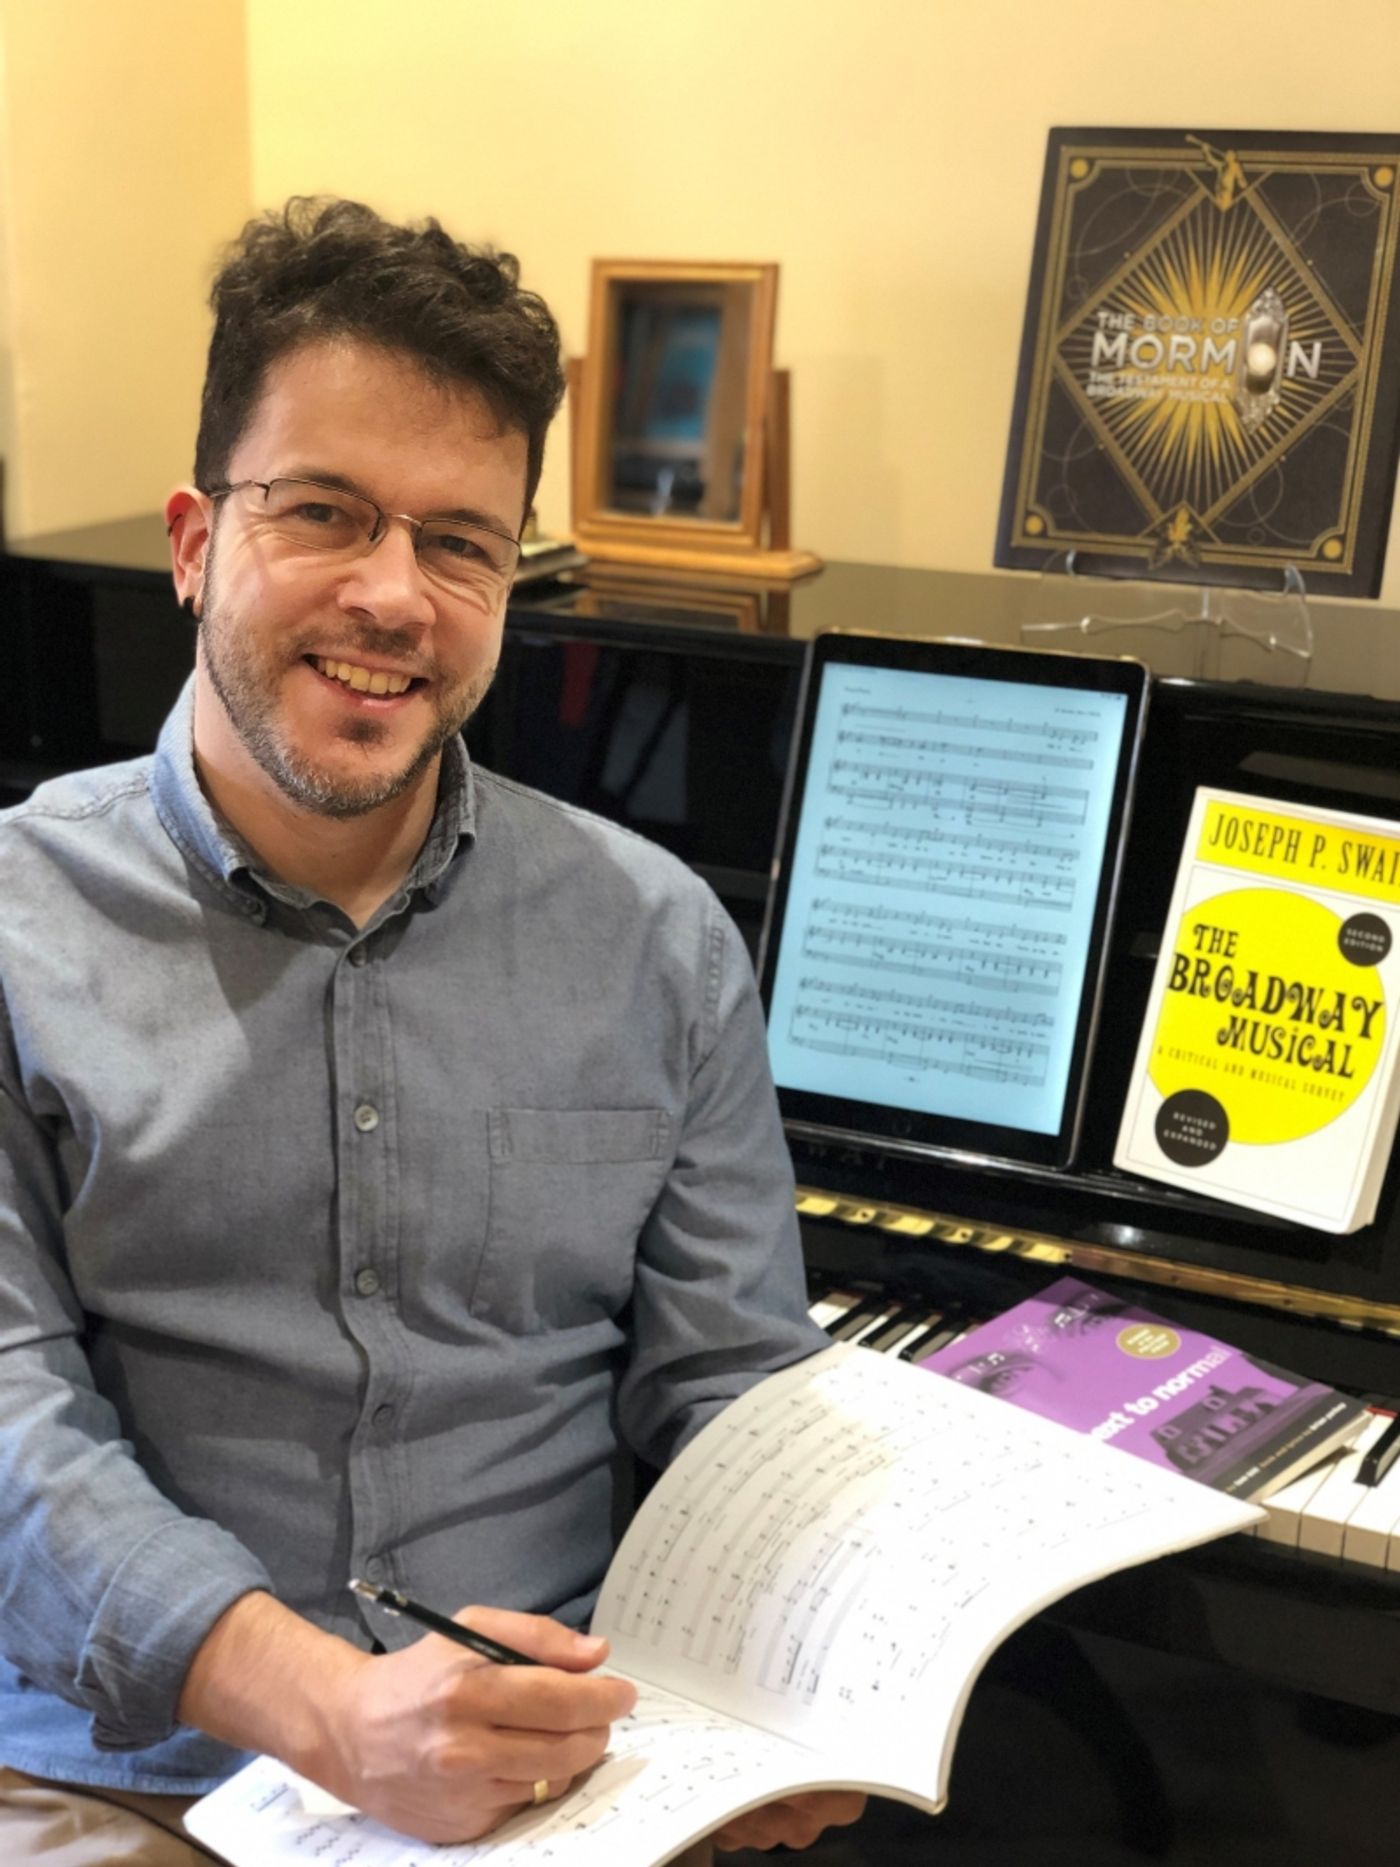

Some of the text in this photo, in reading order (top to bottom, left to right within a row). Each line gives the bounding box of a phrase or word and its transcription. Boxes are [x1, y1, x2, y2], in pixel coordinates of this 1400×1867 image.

[1097, 311, 1239, 334] THE BOOK OF
[1208, 813, 1400, 889] JOSEPH P. SWAI
[1193, 923, 1239, 959] THE
[1343, 937, 1384, 953] EDITION
[1345, 927, 1386, 944] SECOND
[1167, 952, 1384, 1040] BROADWAY
[1223, 1061, 1246, 1078] AND
[1173, 1111, 1217, 1131] REVISED
[1181, 1124, 1204, 1137] AND
[1163, 1128, 1218, 1151] EXPANDED
[1090, 1345, 1234, 1440] ext to normal
